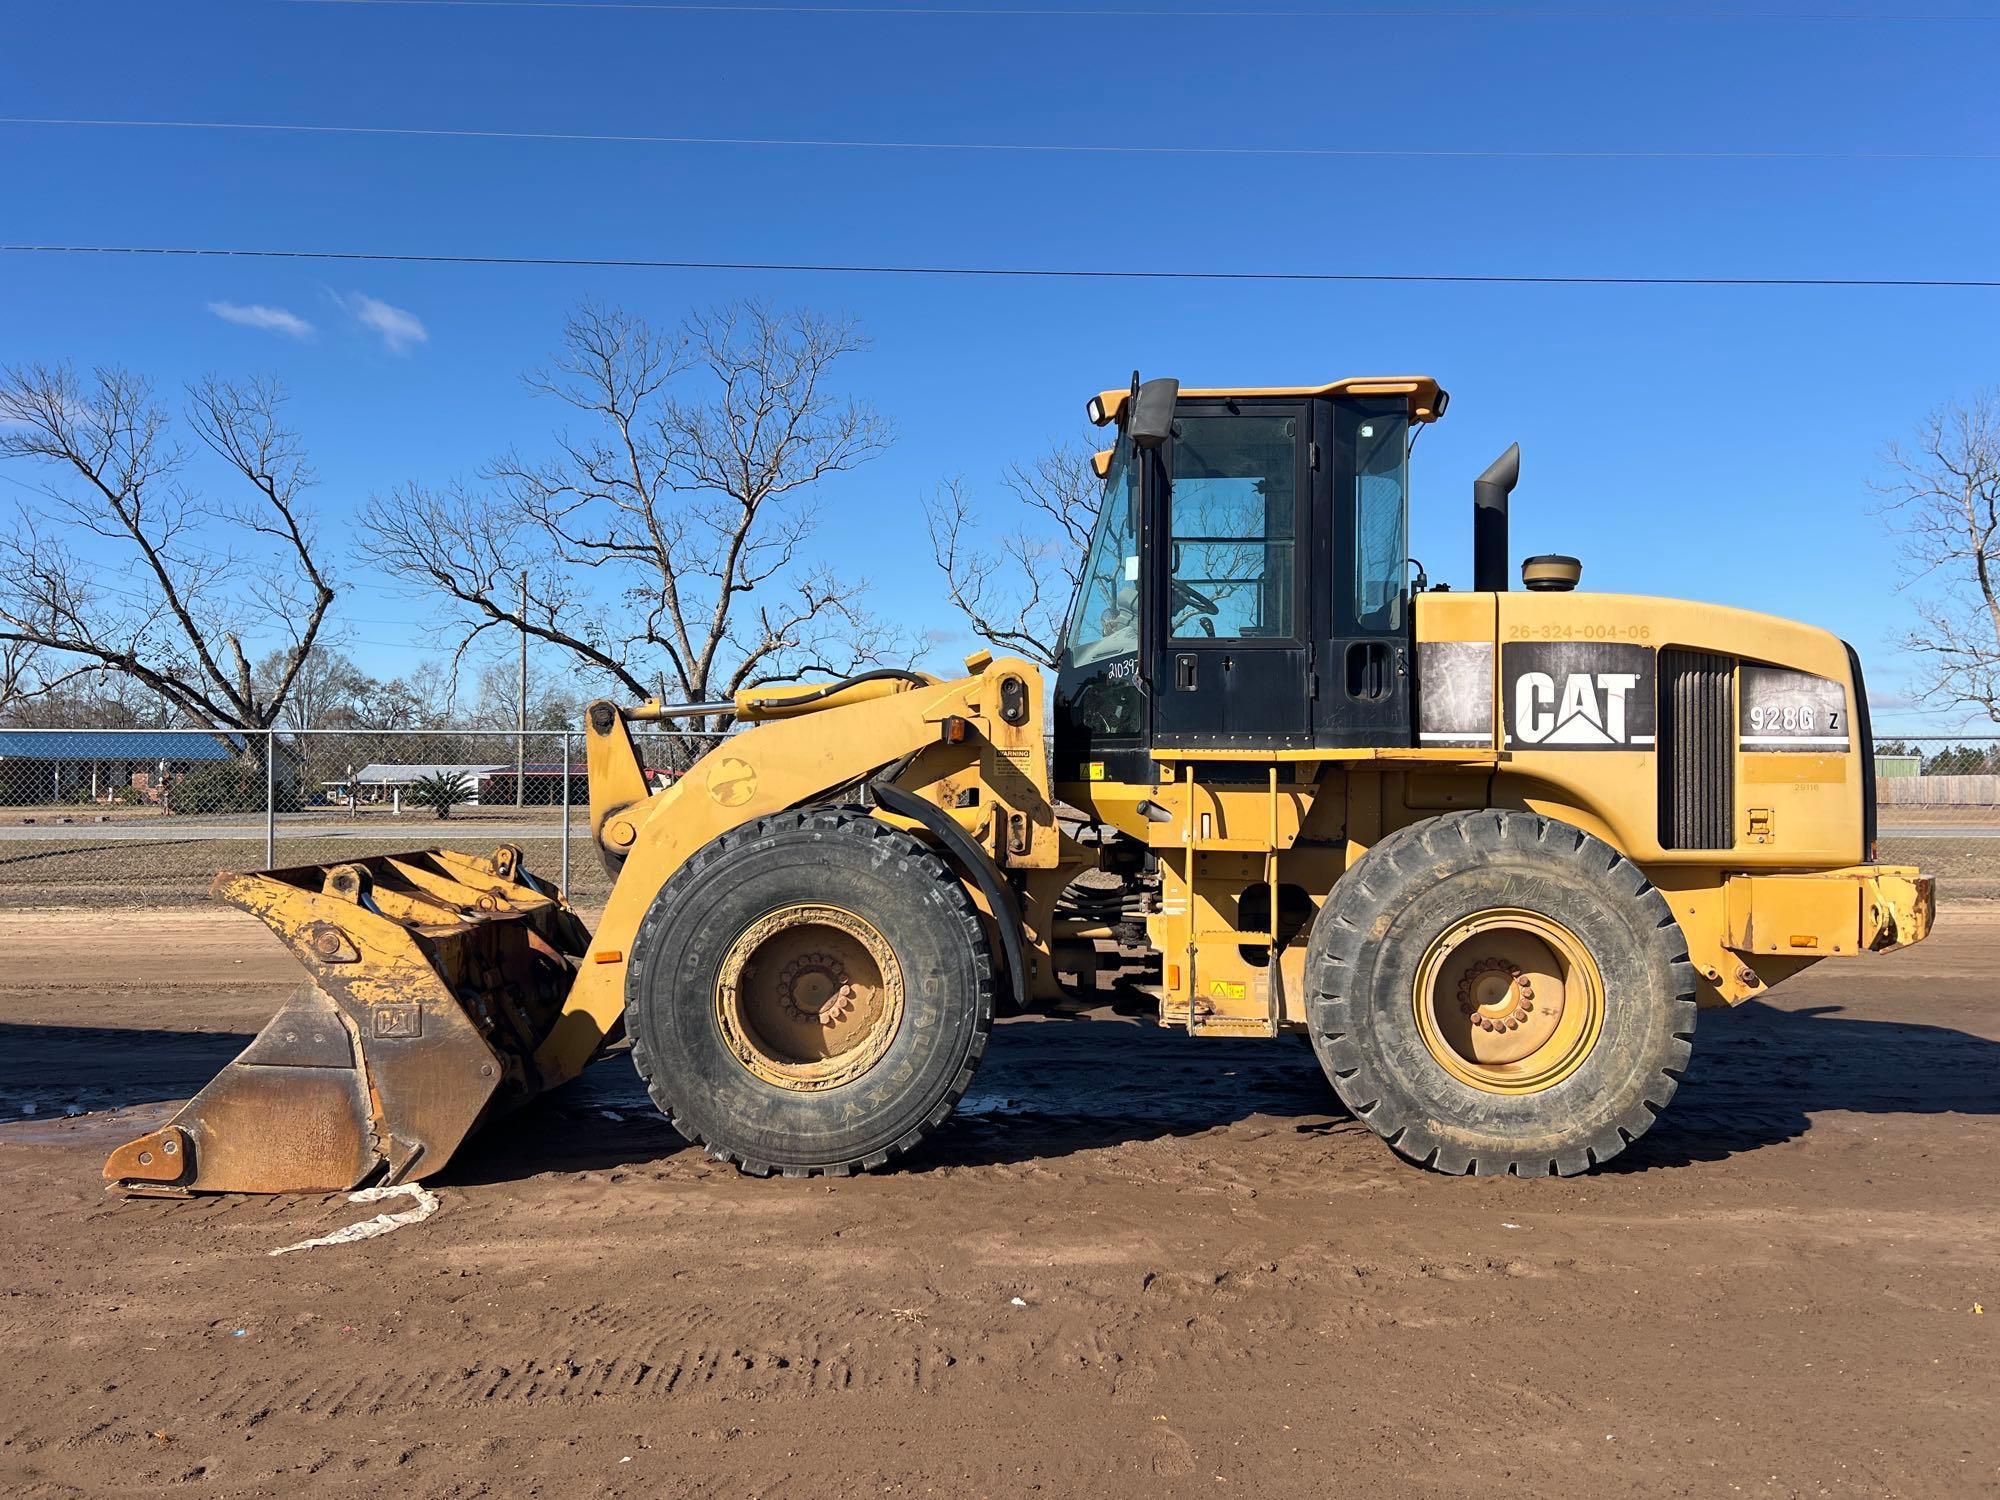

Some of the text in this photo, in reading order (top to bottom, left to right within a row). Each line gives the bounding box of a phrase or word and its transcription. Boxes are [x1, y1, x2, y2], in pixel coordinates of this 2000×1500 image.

[1509, 625, 1650, 639] 26-324-004-06
[1516, 672, 1636, 743] CAT
[1750, 706, 1839, 730] 928G Z
[840, 976, 940, 1127] GALAXY
